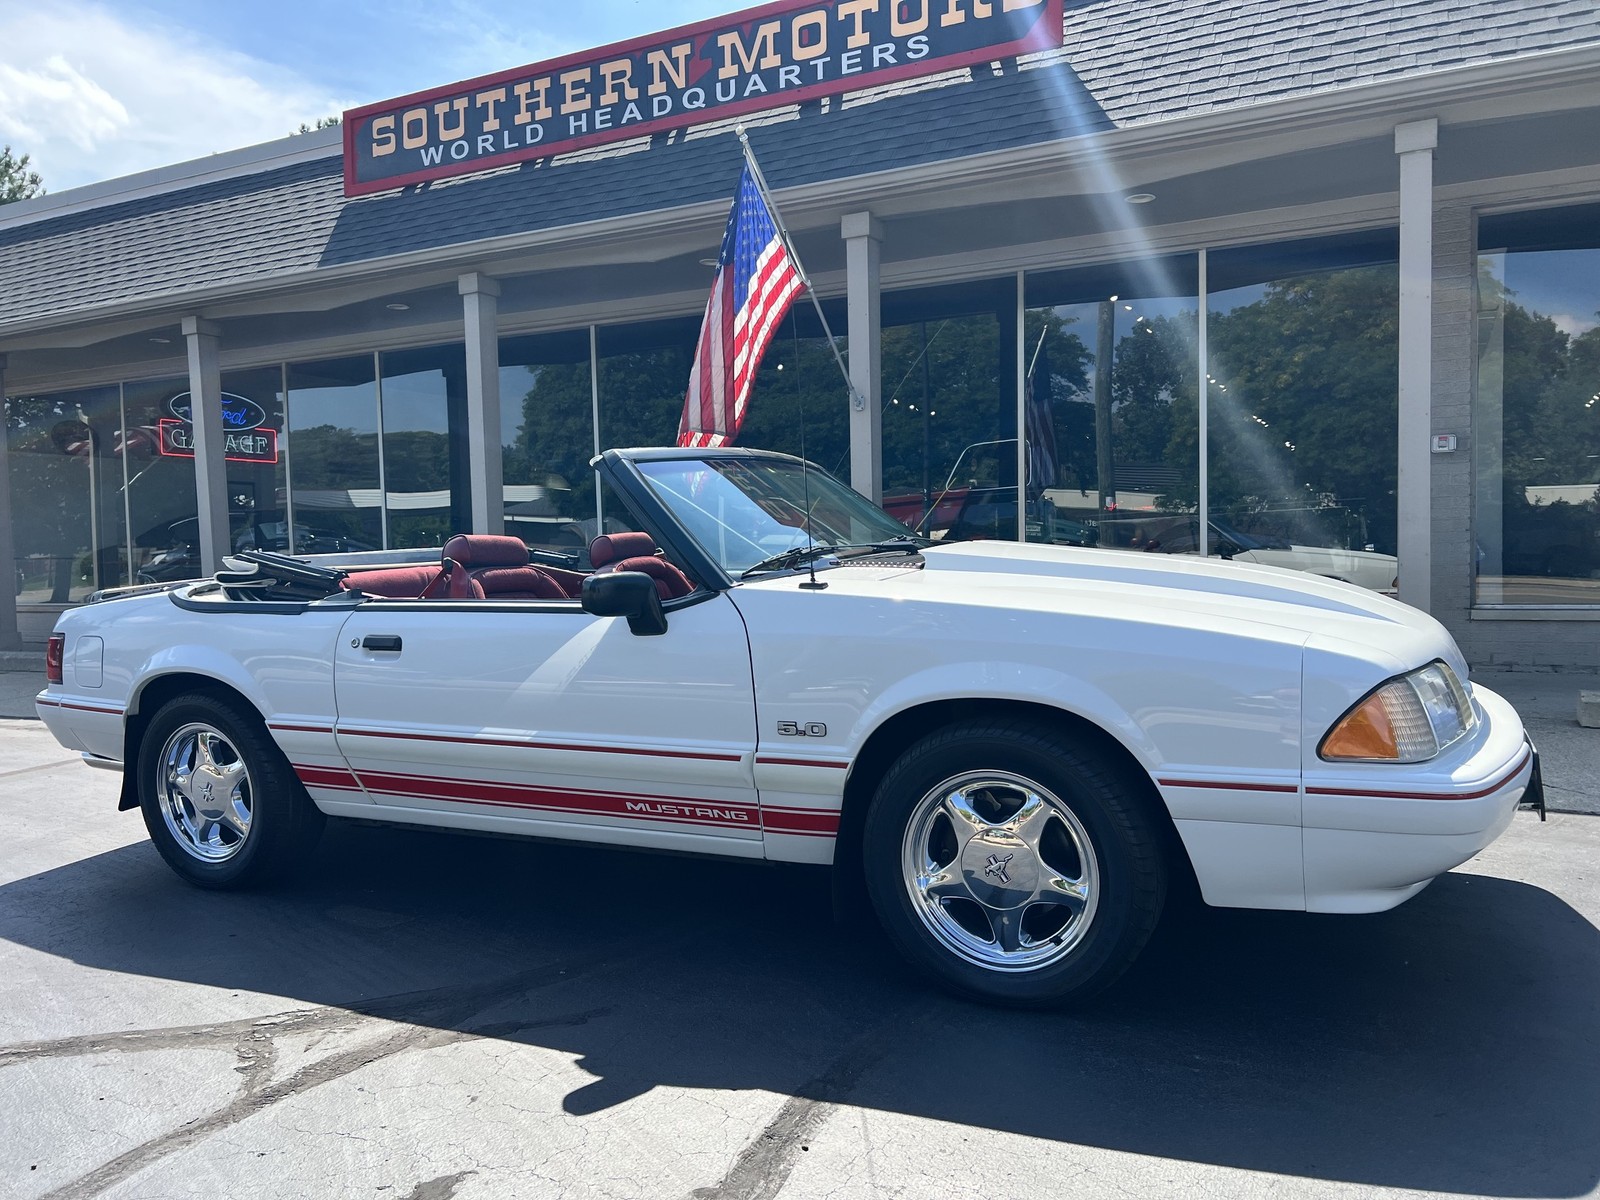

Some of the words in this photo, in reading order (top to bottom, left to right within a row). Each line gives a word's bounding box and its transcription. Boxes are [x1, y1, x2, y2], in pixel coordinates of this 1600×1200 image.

[371, 42, 692, 158] SOUTHERN
[420, 123, 545, 167] WORLD
[568, 35, 930, 136] HEADQUARTERS
[171, 428, 268, 454] GAGE
[777, 720, 827, 738] 5.0
[625, 801, 749, 821] MUSTANG
